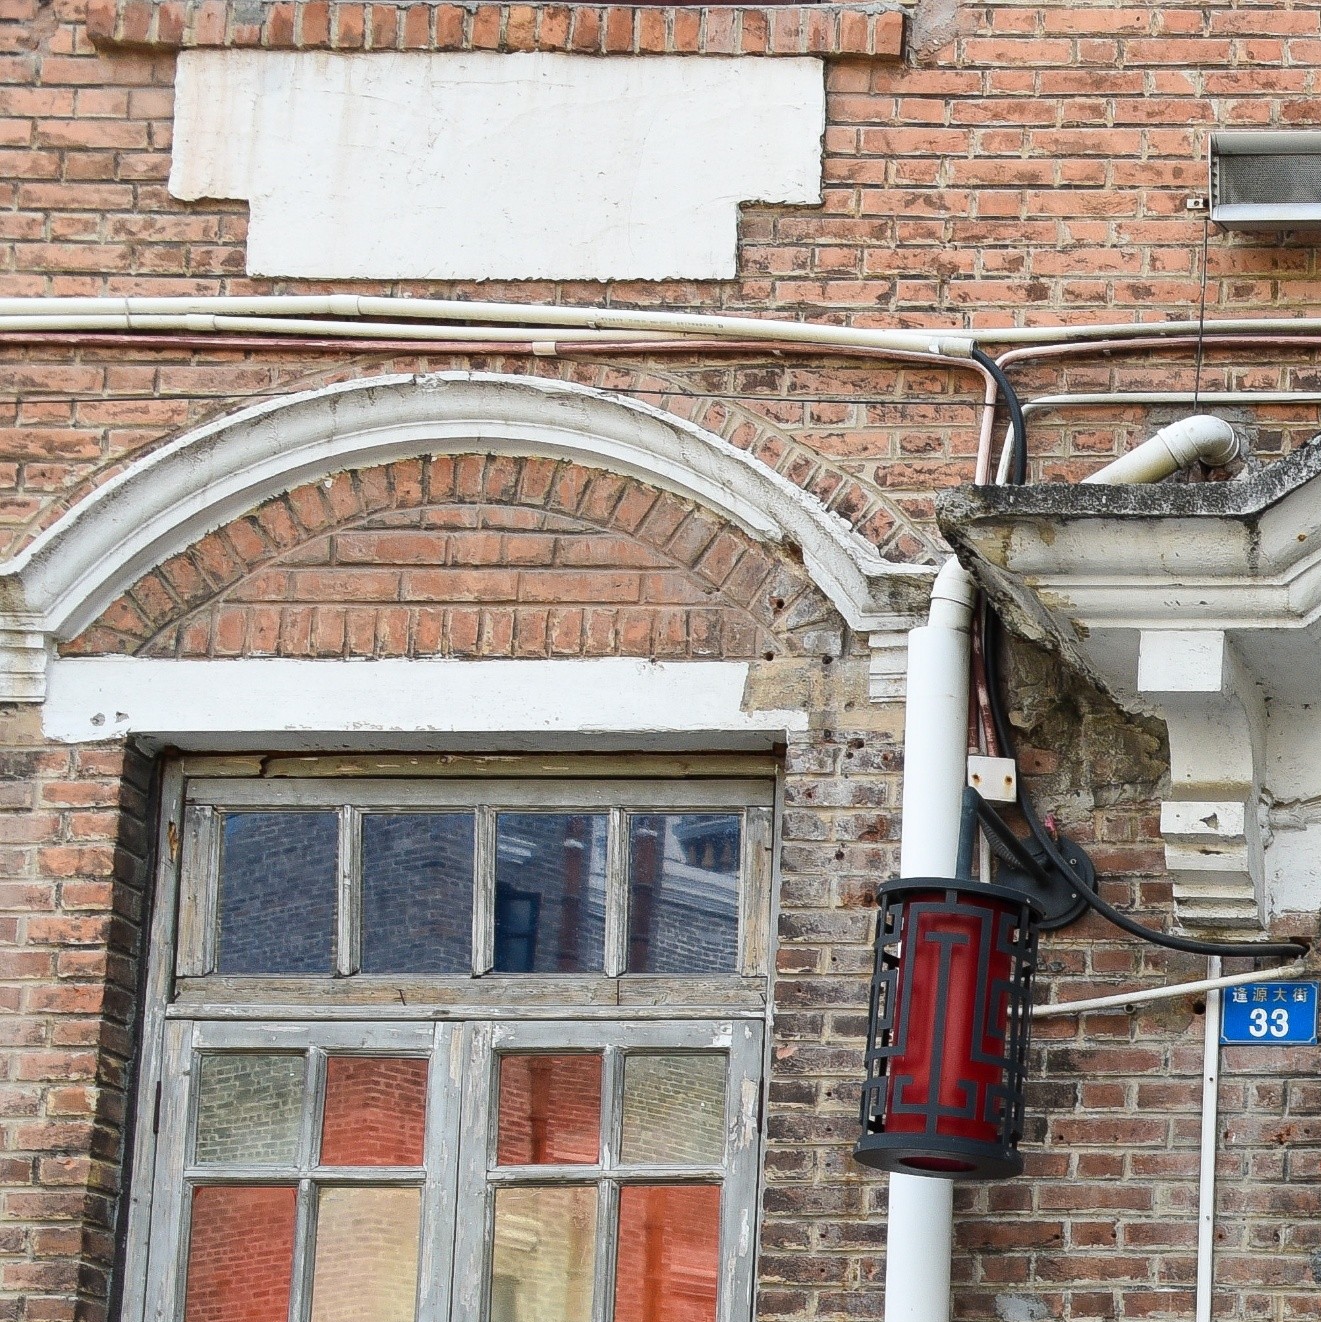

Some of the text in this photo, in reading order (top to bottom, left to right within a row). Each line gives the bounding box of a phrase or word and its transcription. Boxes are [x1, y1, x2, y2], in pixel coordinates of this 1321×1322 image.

[1232, 987, 1309, 1003] 逢源大街
[1249, 1008, 1289, 1038] 33
